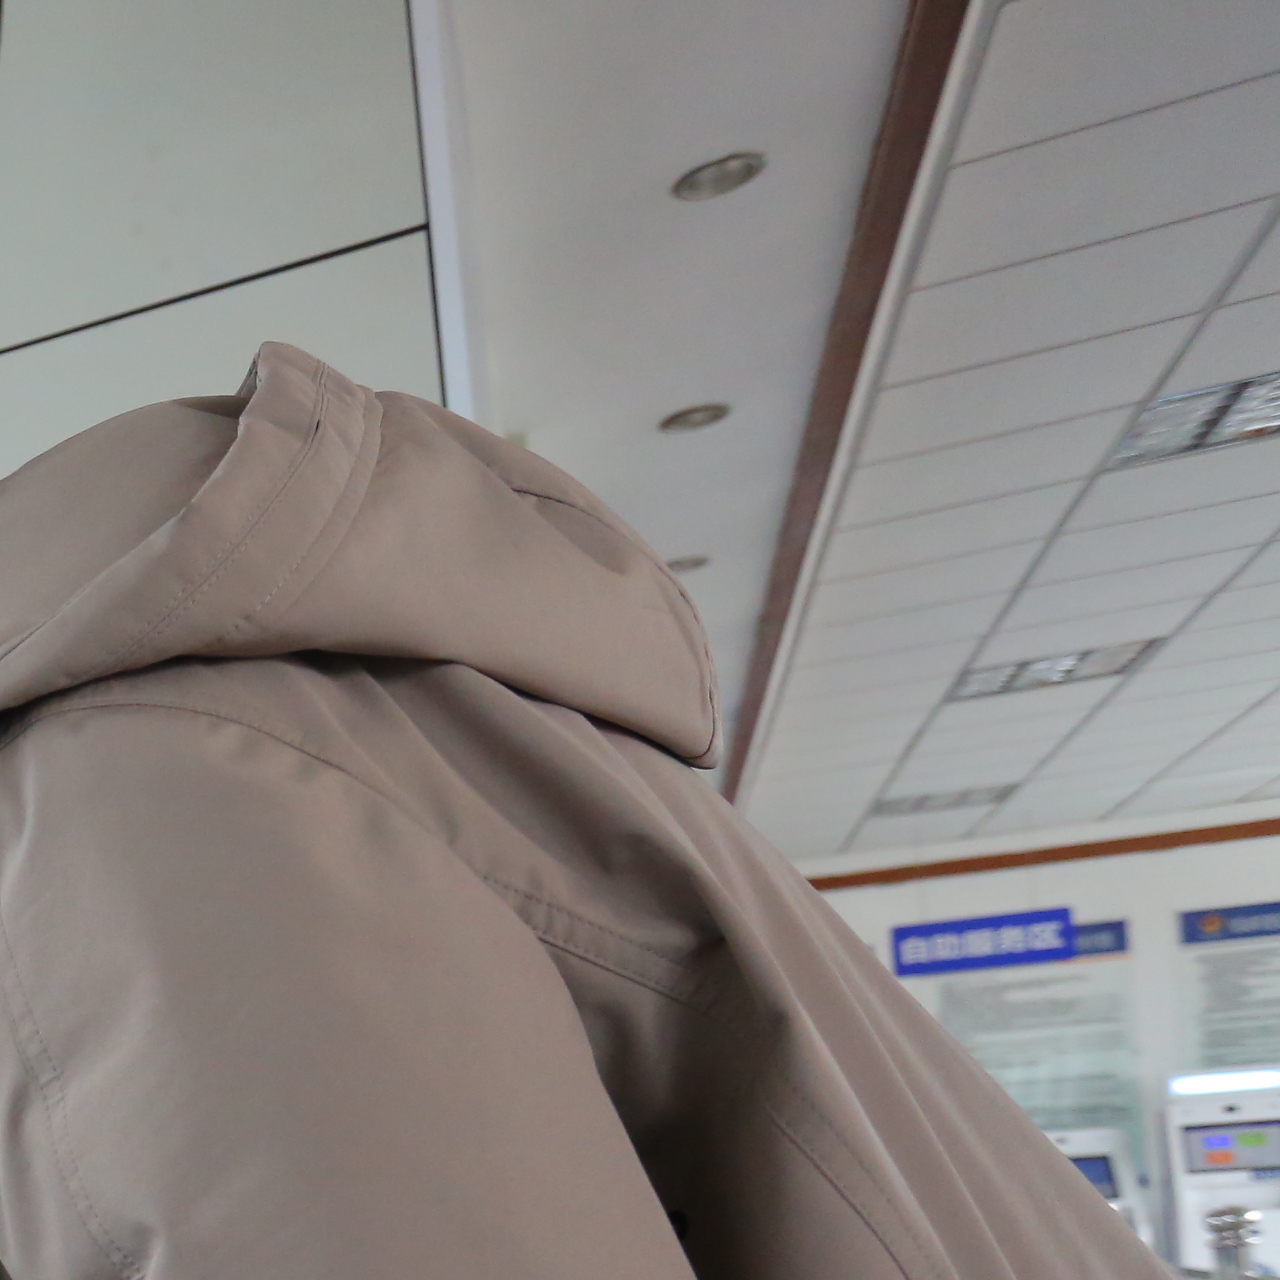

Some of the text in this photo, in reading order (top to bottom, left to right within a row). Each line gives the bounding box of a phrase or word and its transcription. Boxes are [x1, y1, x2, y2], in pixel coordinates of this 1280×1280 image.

[898, 921, 1067, 967] 自助服务区
